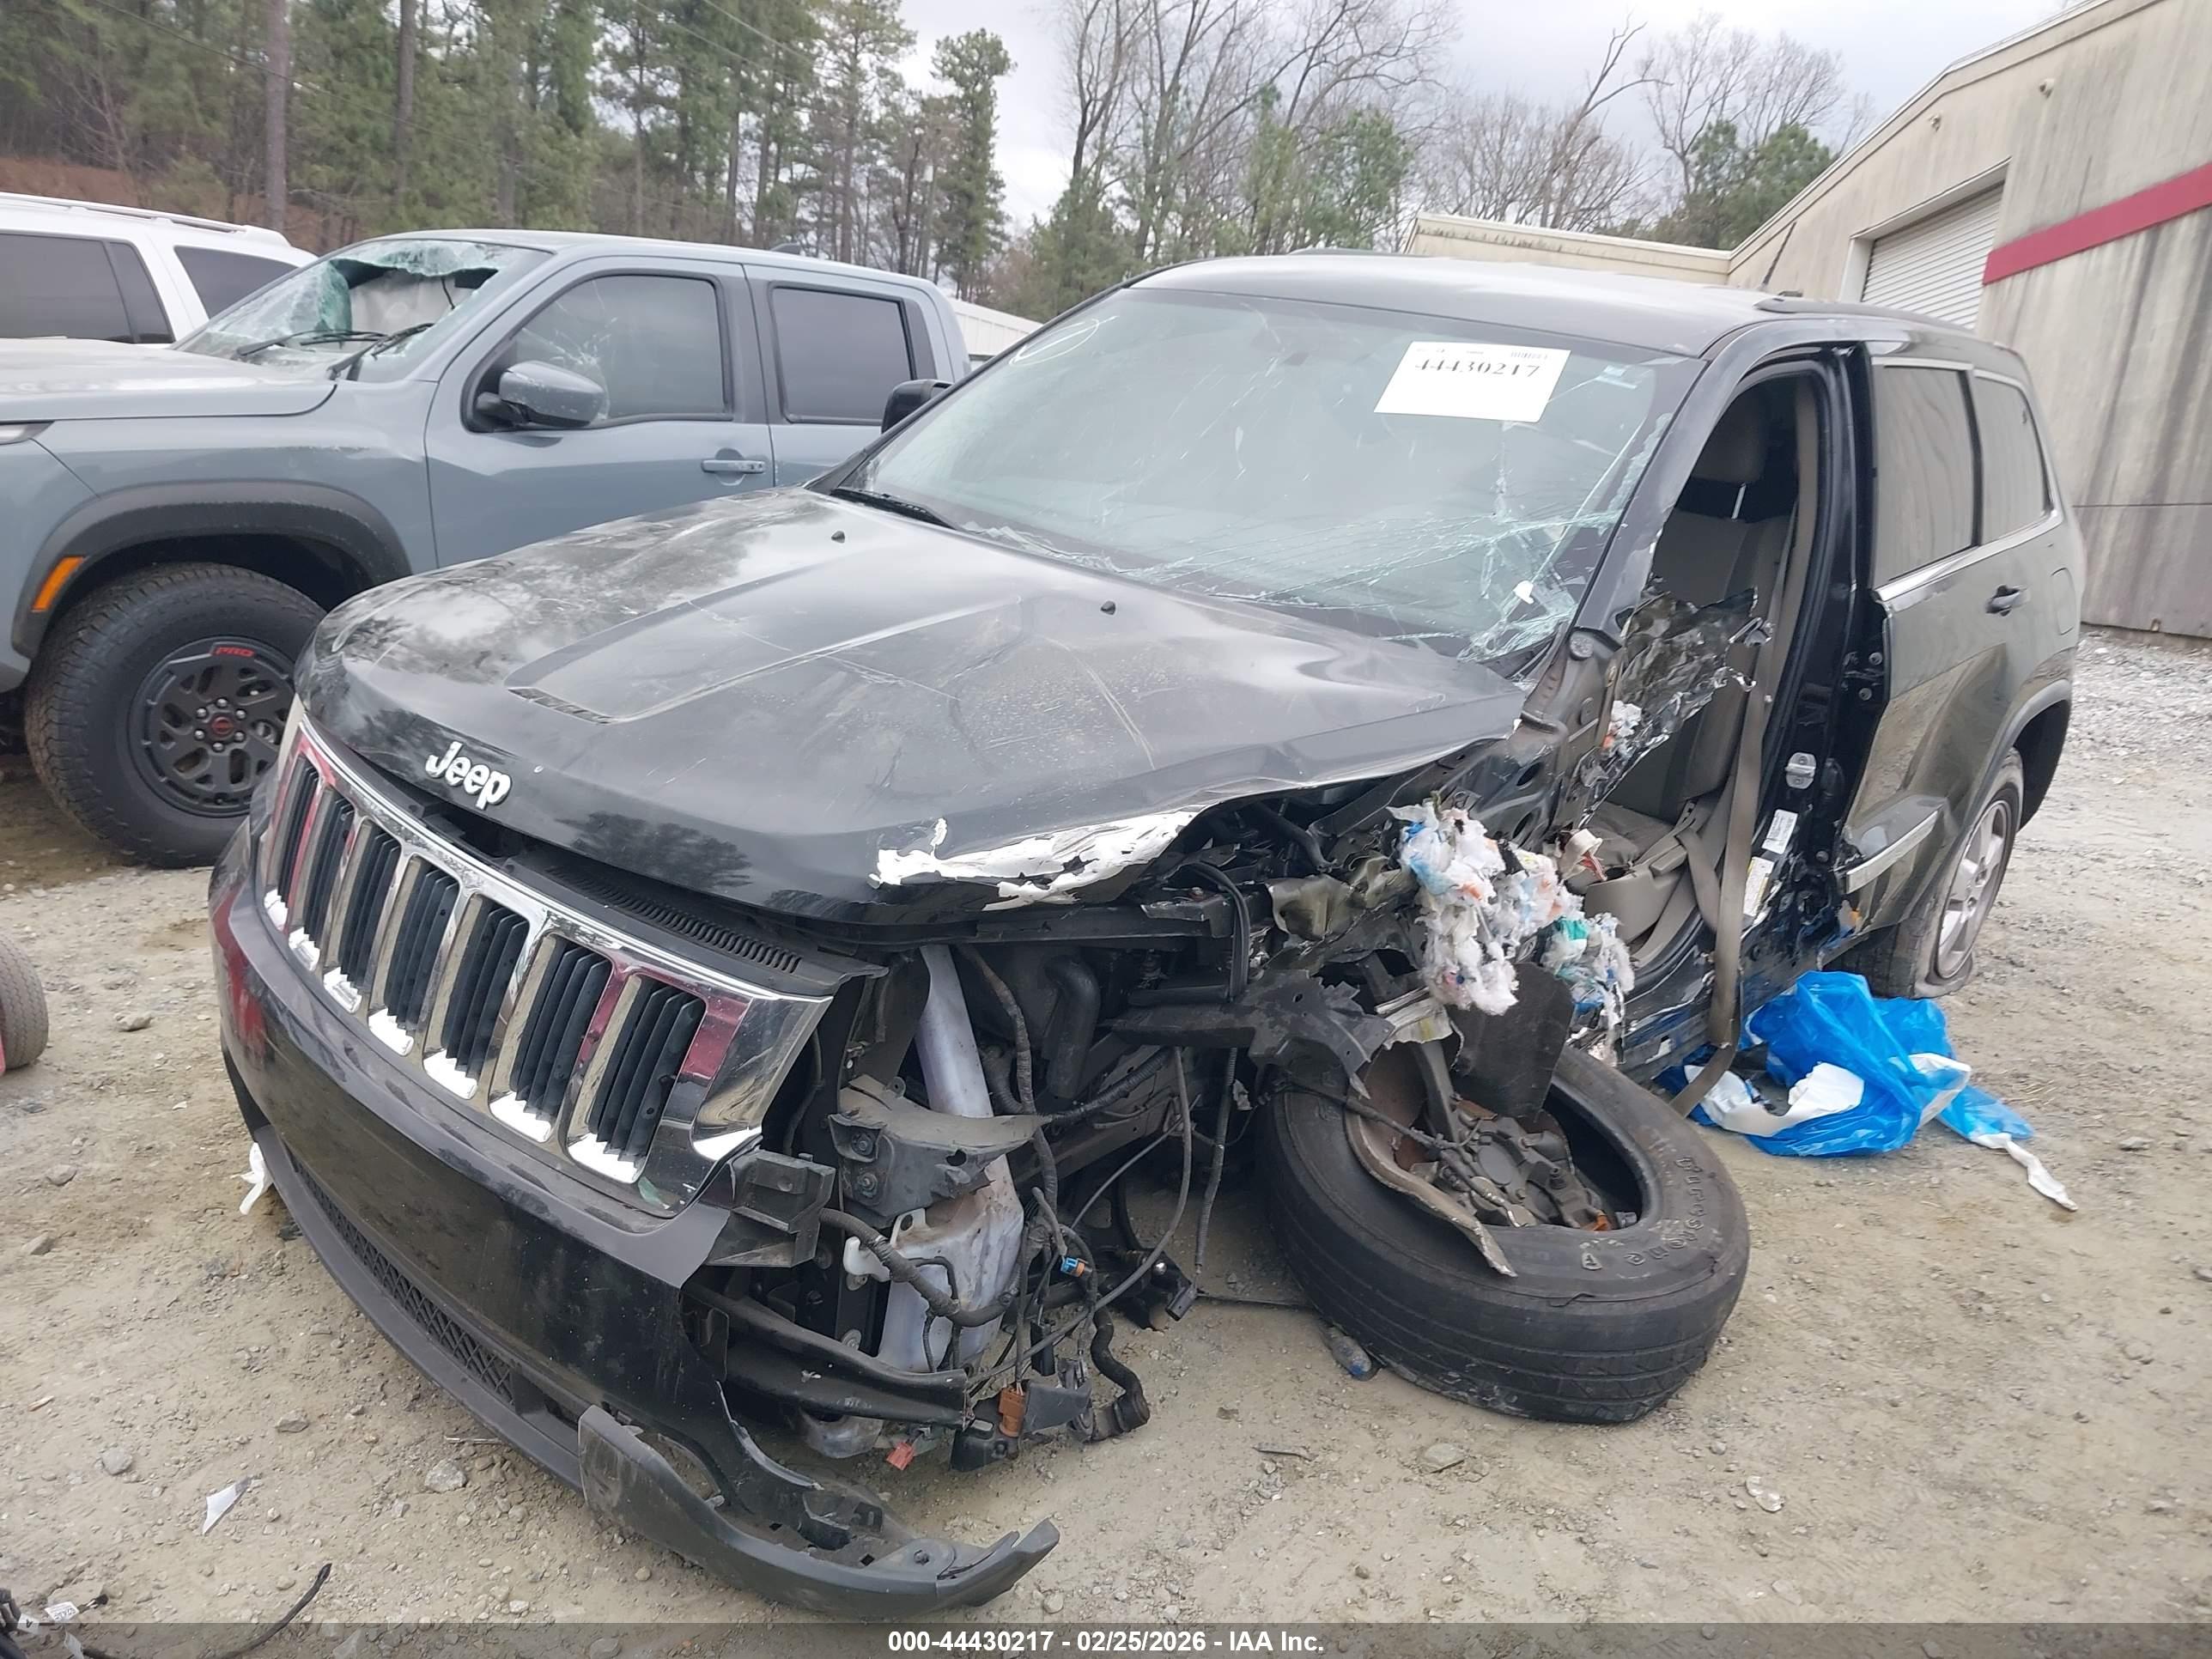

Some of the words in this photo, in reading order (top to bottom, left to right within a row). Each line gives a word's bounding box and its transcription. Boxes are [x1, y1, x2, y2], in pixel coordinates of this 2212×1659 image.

[1415, 359, 1540, 377] 44430217
[216, 646, 255, 658] PRO
[425, 741, 513, 811] Jeep
